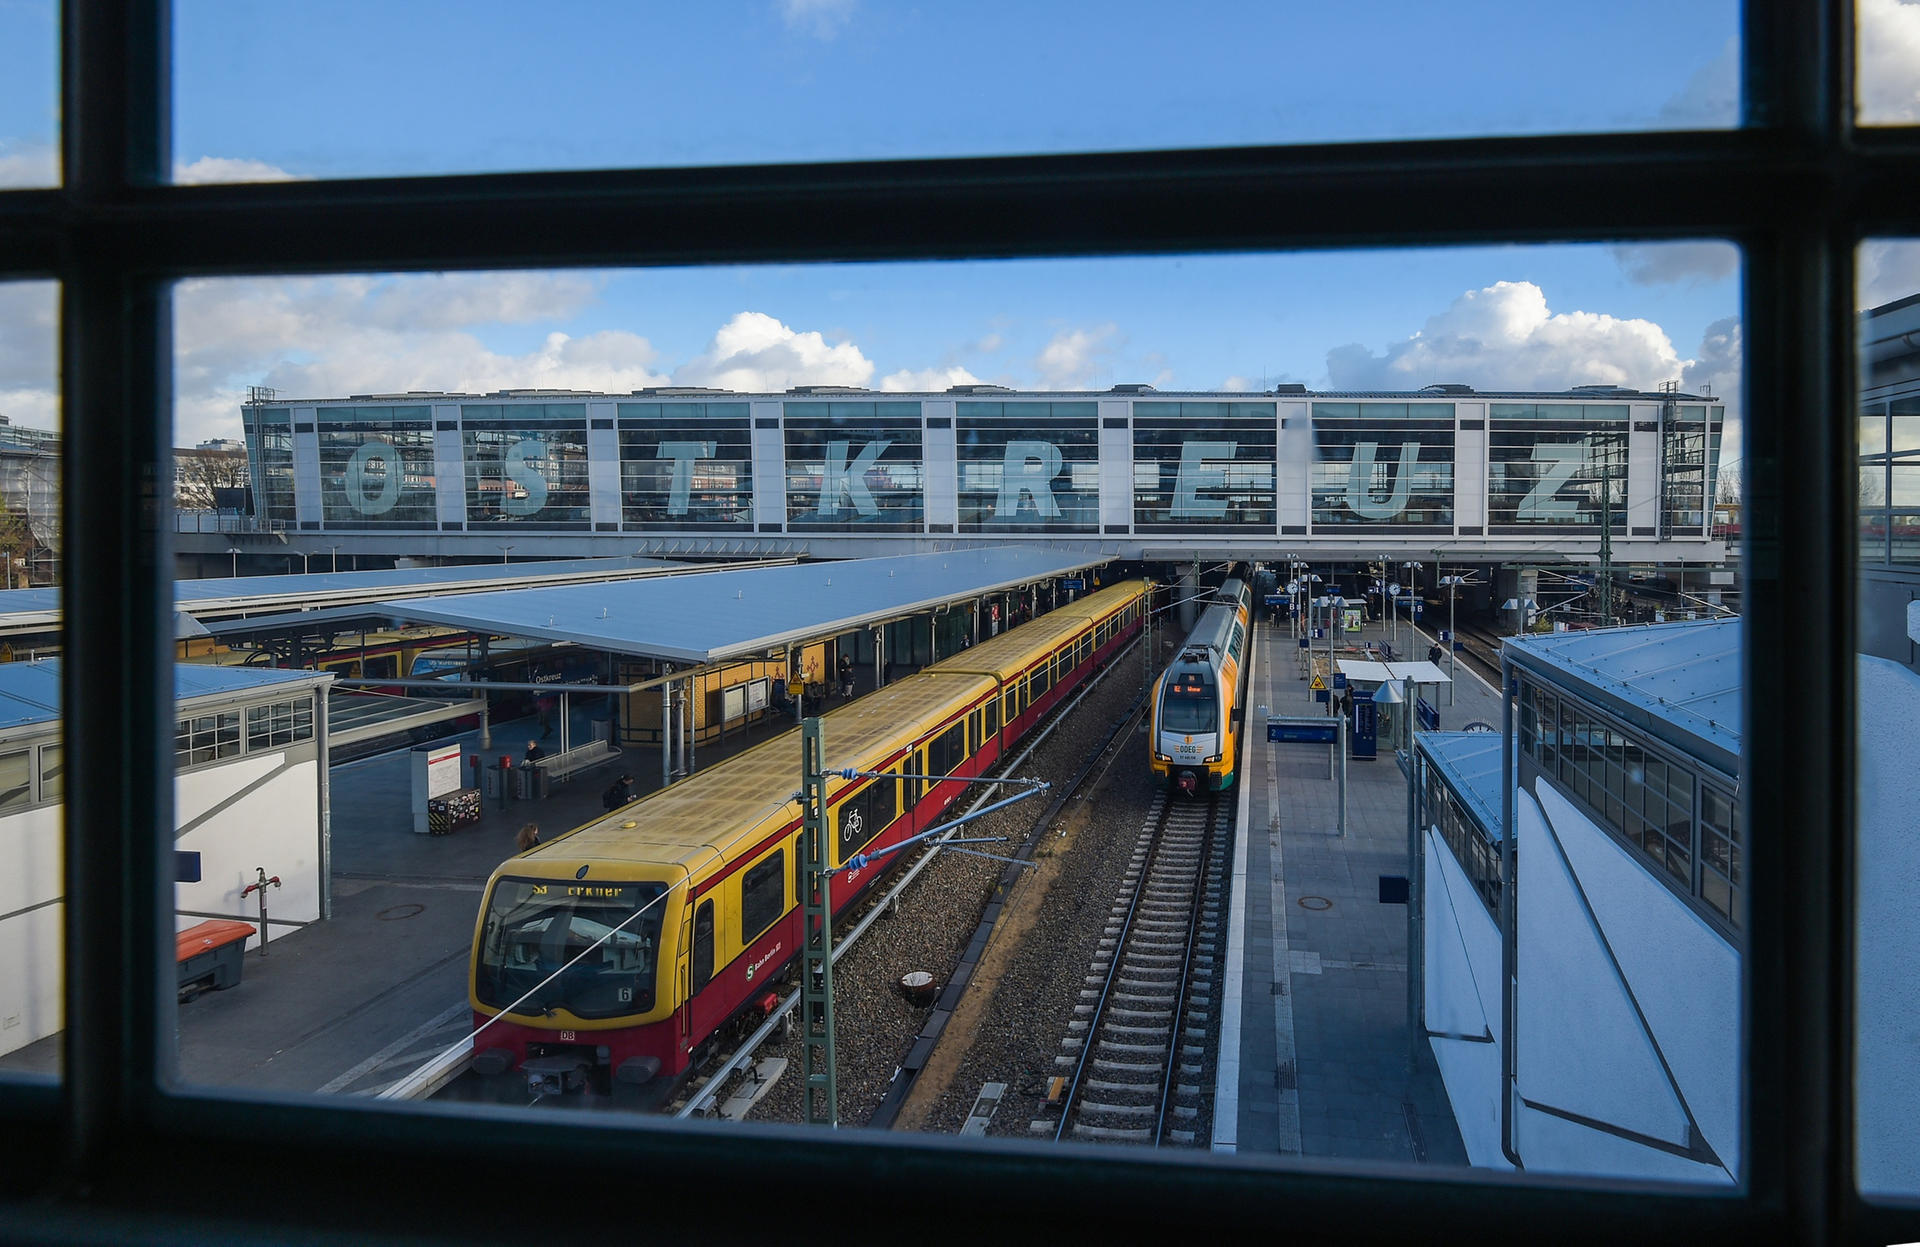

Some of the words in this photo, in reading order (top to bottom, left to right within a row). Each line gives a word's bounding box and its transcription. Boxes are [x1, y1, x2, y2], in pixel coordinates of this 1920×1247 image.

[345, 439, 1600, 520] OSTKREUZ
[535, 672, 562, 684] Ostkreuz
[1180, 745, 1196, 753] ODEG
[561, 1031, 575, 1041] DB
